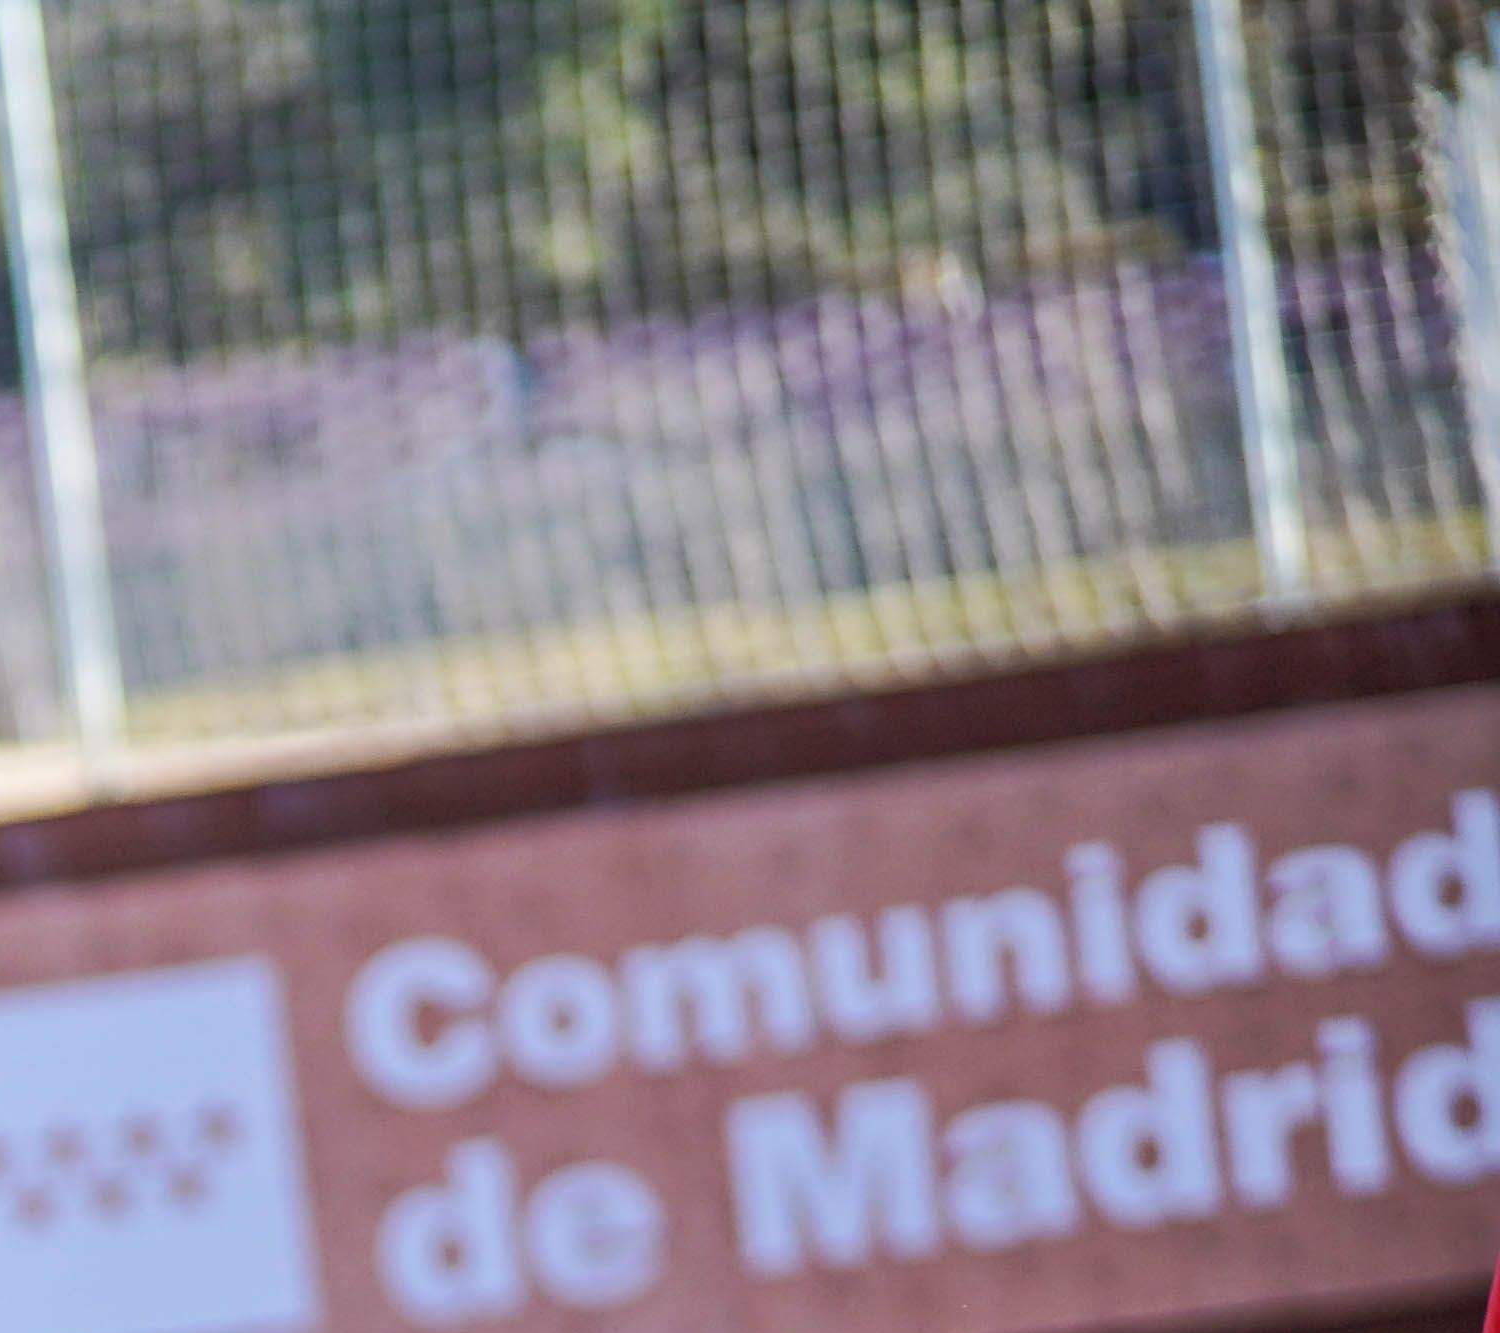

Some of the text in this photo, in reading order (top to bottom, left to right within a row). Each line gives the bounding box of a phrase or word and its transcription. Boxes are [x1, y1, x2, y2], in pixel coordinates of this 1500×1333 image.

[343, 789, 1500, 1112] Comunidad
[376, 997, 1500, 1328] de Madrid
